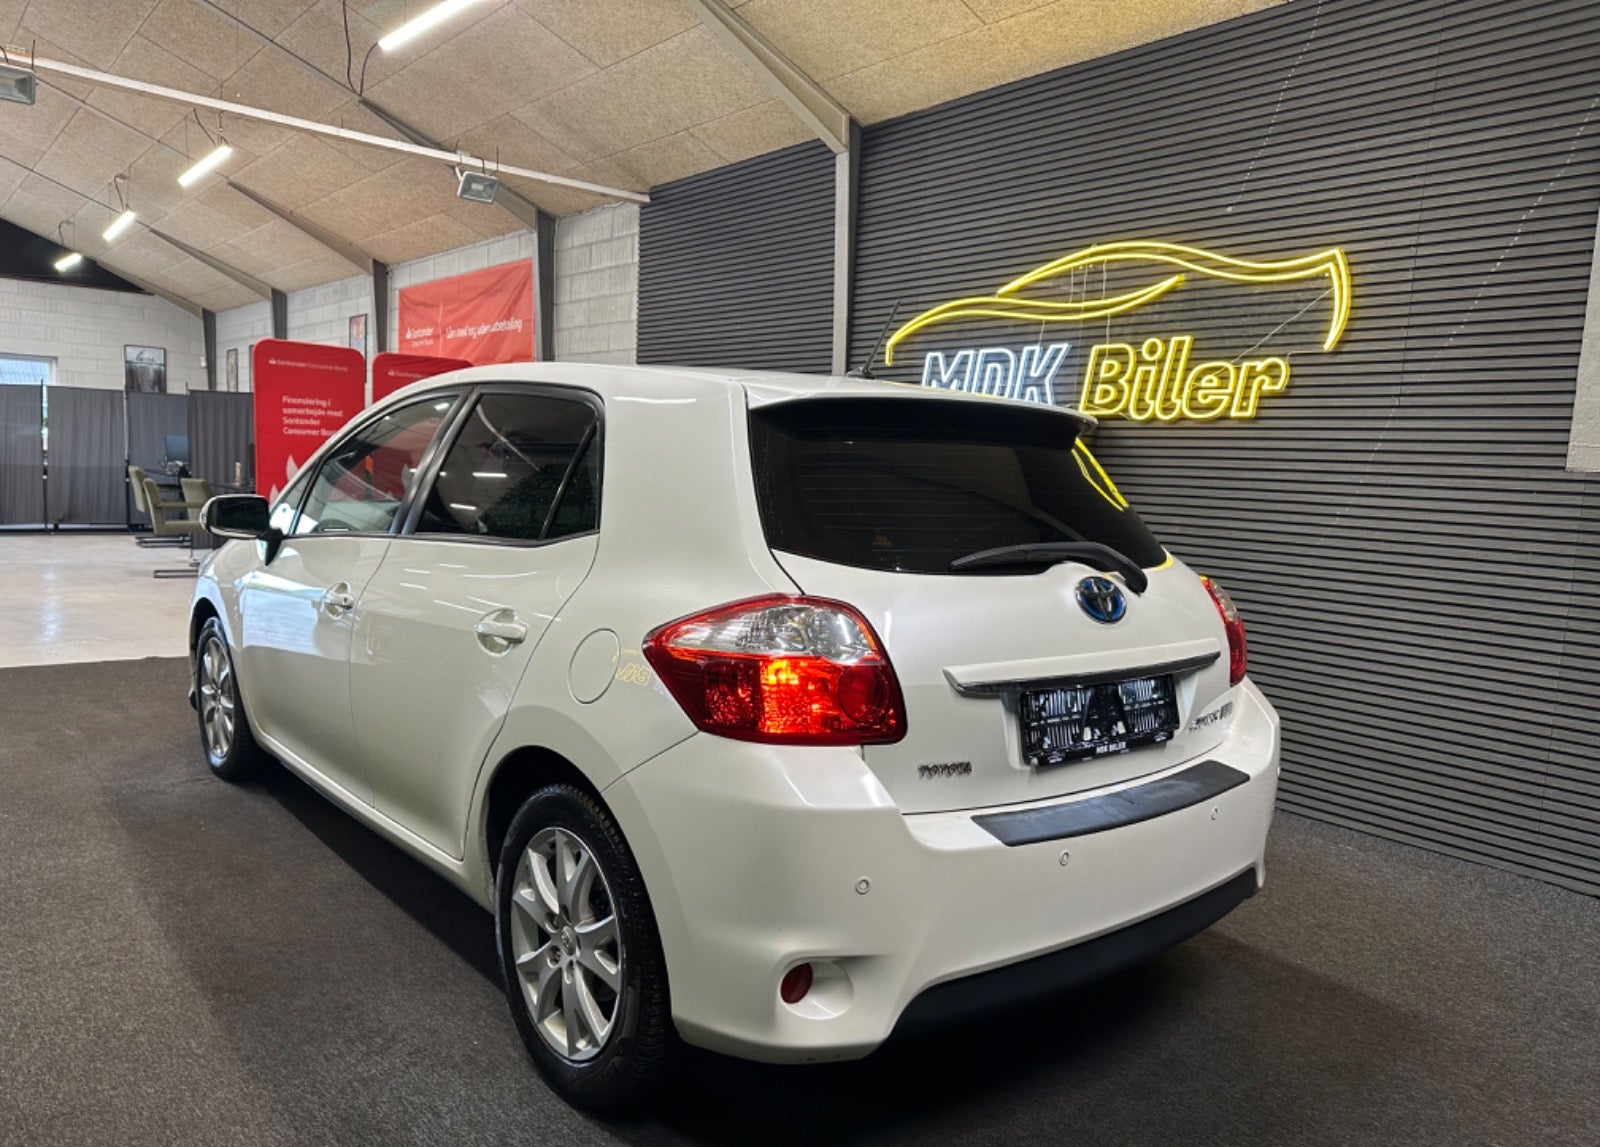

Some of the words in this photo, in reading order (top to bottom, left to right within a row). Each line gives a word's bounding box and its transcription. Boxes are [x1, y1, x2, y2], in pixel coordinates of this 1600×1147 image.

[277, 359, 306, 367] Santander
[921, 342, 1073, 405] MDK
[1078, 335, 1290, 421] Biler
[282, 416, 320, 425] Santander
[283, 427, 319, 435] Consumer
[917, 761, 972, 779] TOYOTA
